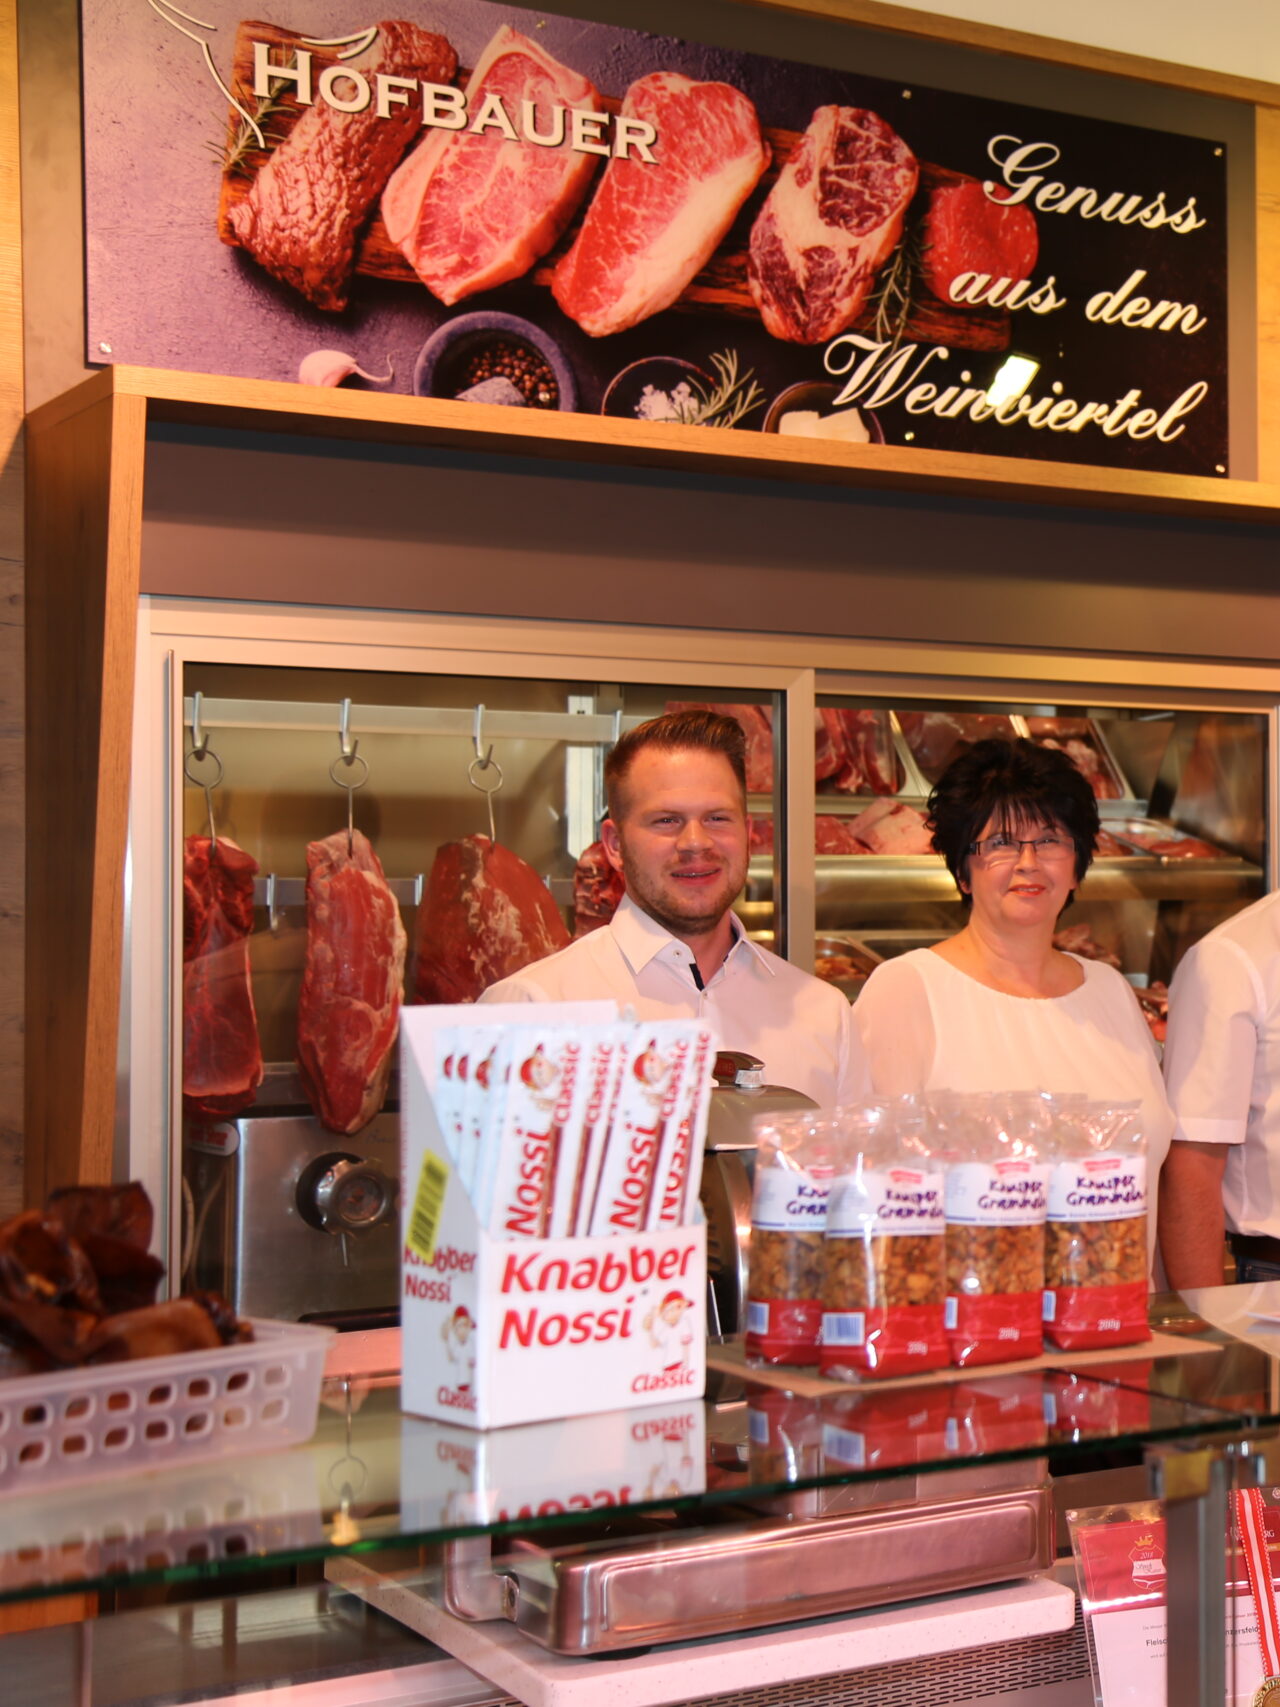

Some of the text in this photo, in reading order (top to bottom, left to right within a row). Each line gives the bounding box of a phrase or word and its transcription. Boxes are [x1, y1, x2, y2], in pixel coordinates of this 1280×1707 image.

[252, 41, 659, 165] HOFBAUER
[983, 134, 1206, 234] Genuss
[948, 270, 1208, 335] aus dem
[505, 1128, 551, 1237] Nossi
[609, 1122, 657, 1228] Nossi
[404, 1273, 452, 1303] Nossi
[501, 1244, 697, 1294] Knabber
[499, 1295, 635, 1349] Nossi
[631, 1367, 695, 1394] Classic
